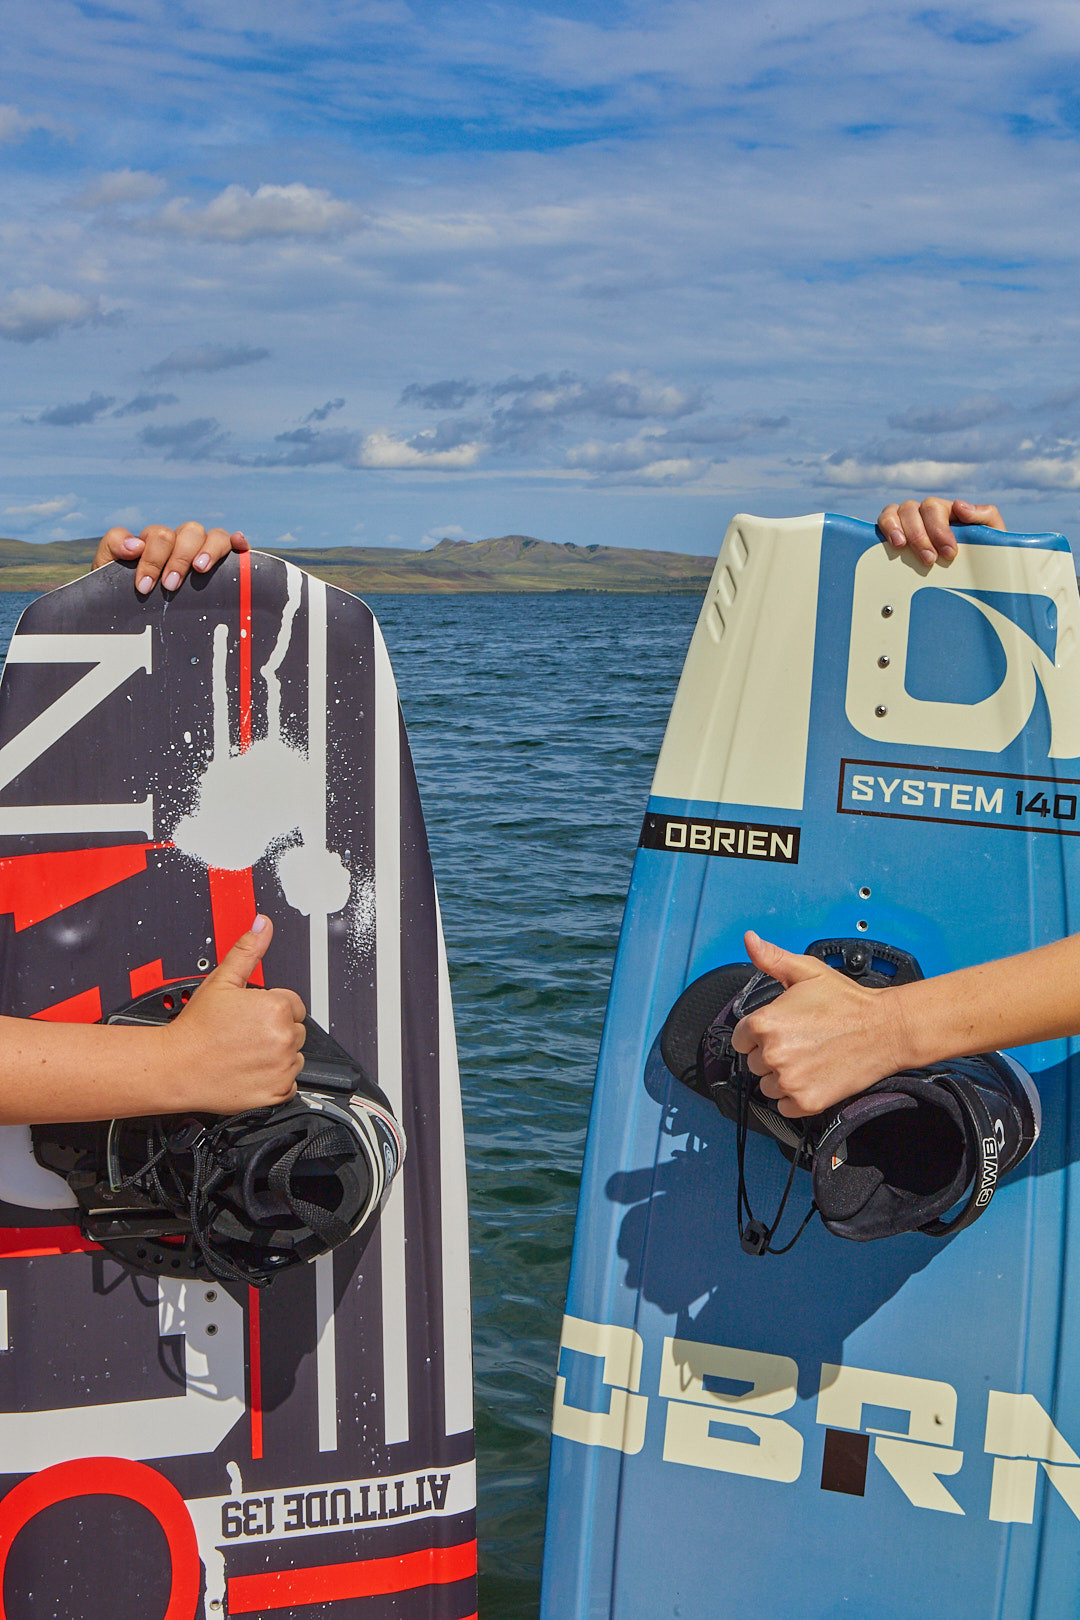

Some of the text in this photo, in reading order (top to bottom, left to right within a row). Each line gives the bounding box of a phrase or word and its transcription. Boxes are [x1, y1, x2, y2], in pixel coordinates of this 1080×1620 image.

[852, 775, 1078, 821] SYSTEM 140
[665, 822, 794, 859] OBRIEN
[976, 1137, 998, 1207] CWB
[221, 1473, 451, 1539] ATTITUDE 139
